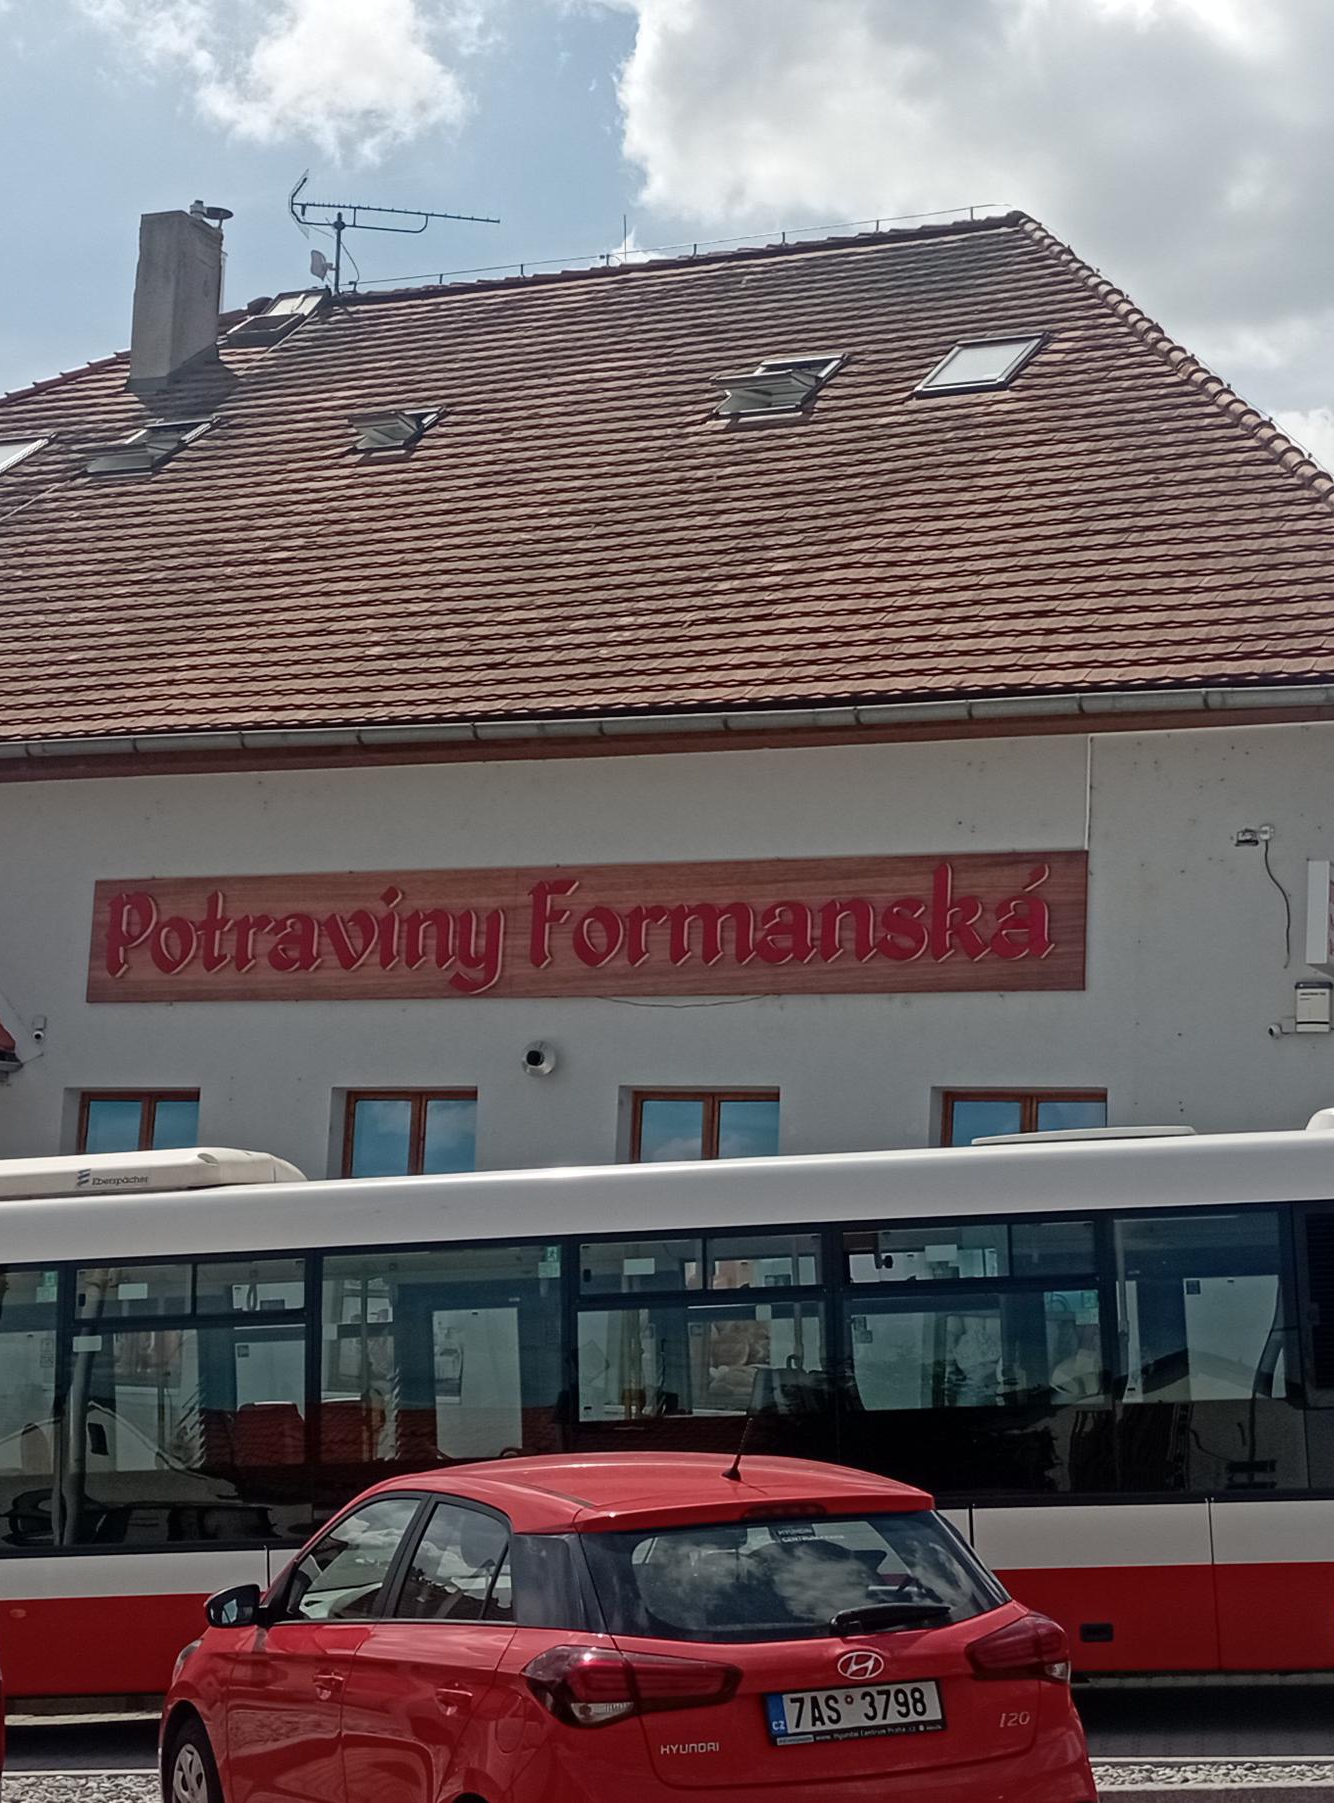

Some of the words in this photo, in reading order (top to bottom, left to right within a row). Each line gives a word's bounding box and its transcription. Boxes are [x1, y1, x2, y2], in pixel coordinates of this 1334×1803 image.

[106, 885, 505, 995] Potraviny
[528, 863, 1055, 969] Formanská
[790, 1693, 842, 1729] 7AS
[861, 1687, 928, 1722] 3798
[772, 1721, 785, 1731] CZ
[660, 1742, 720, 1755] HYUNDAI
